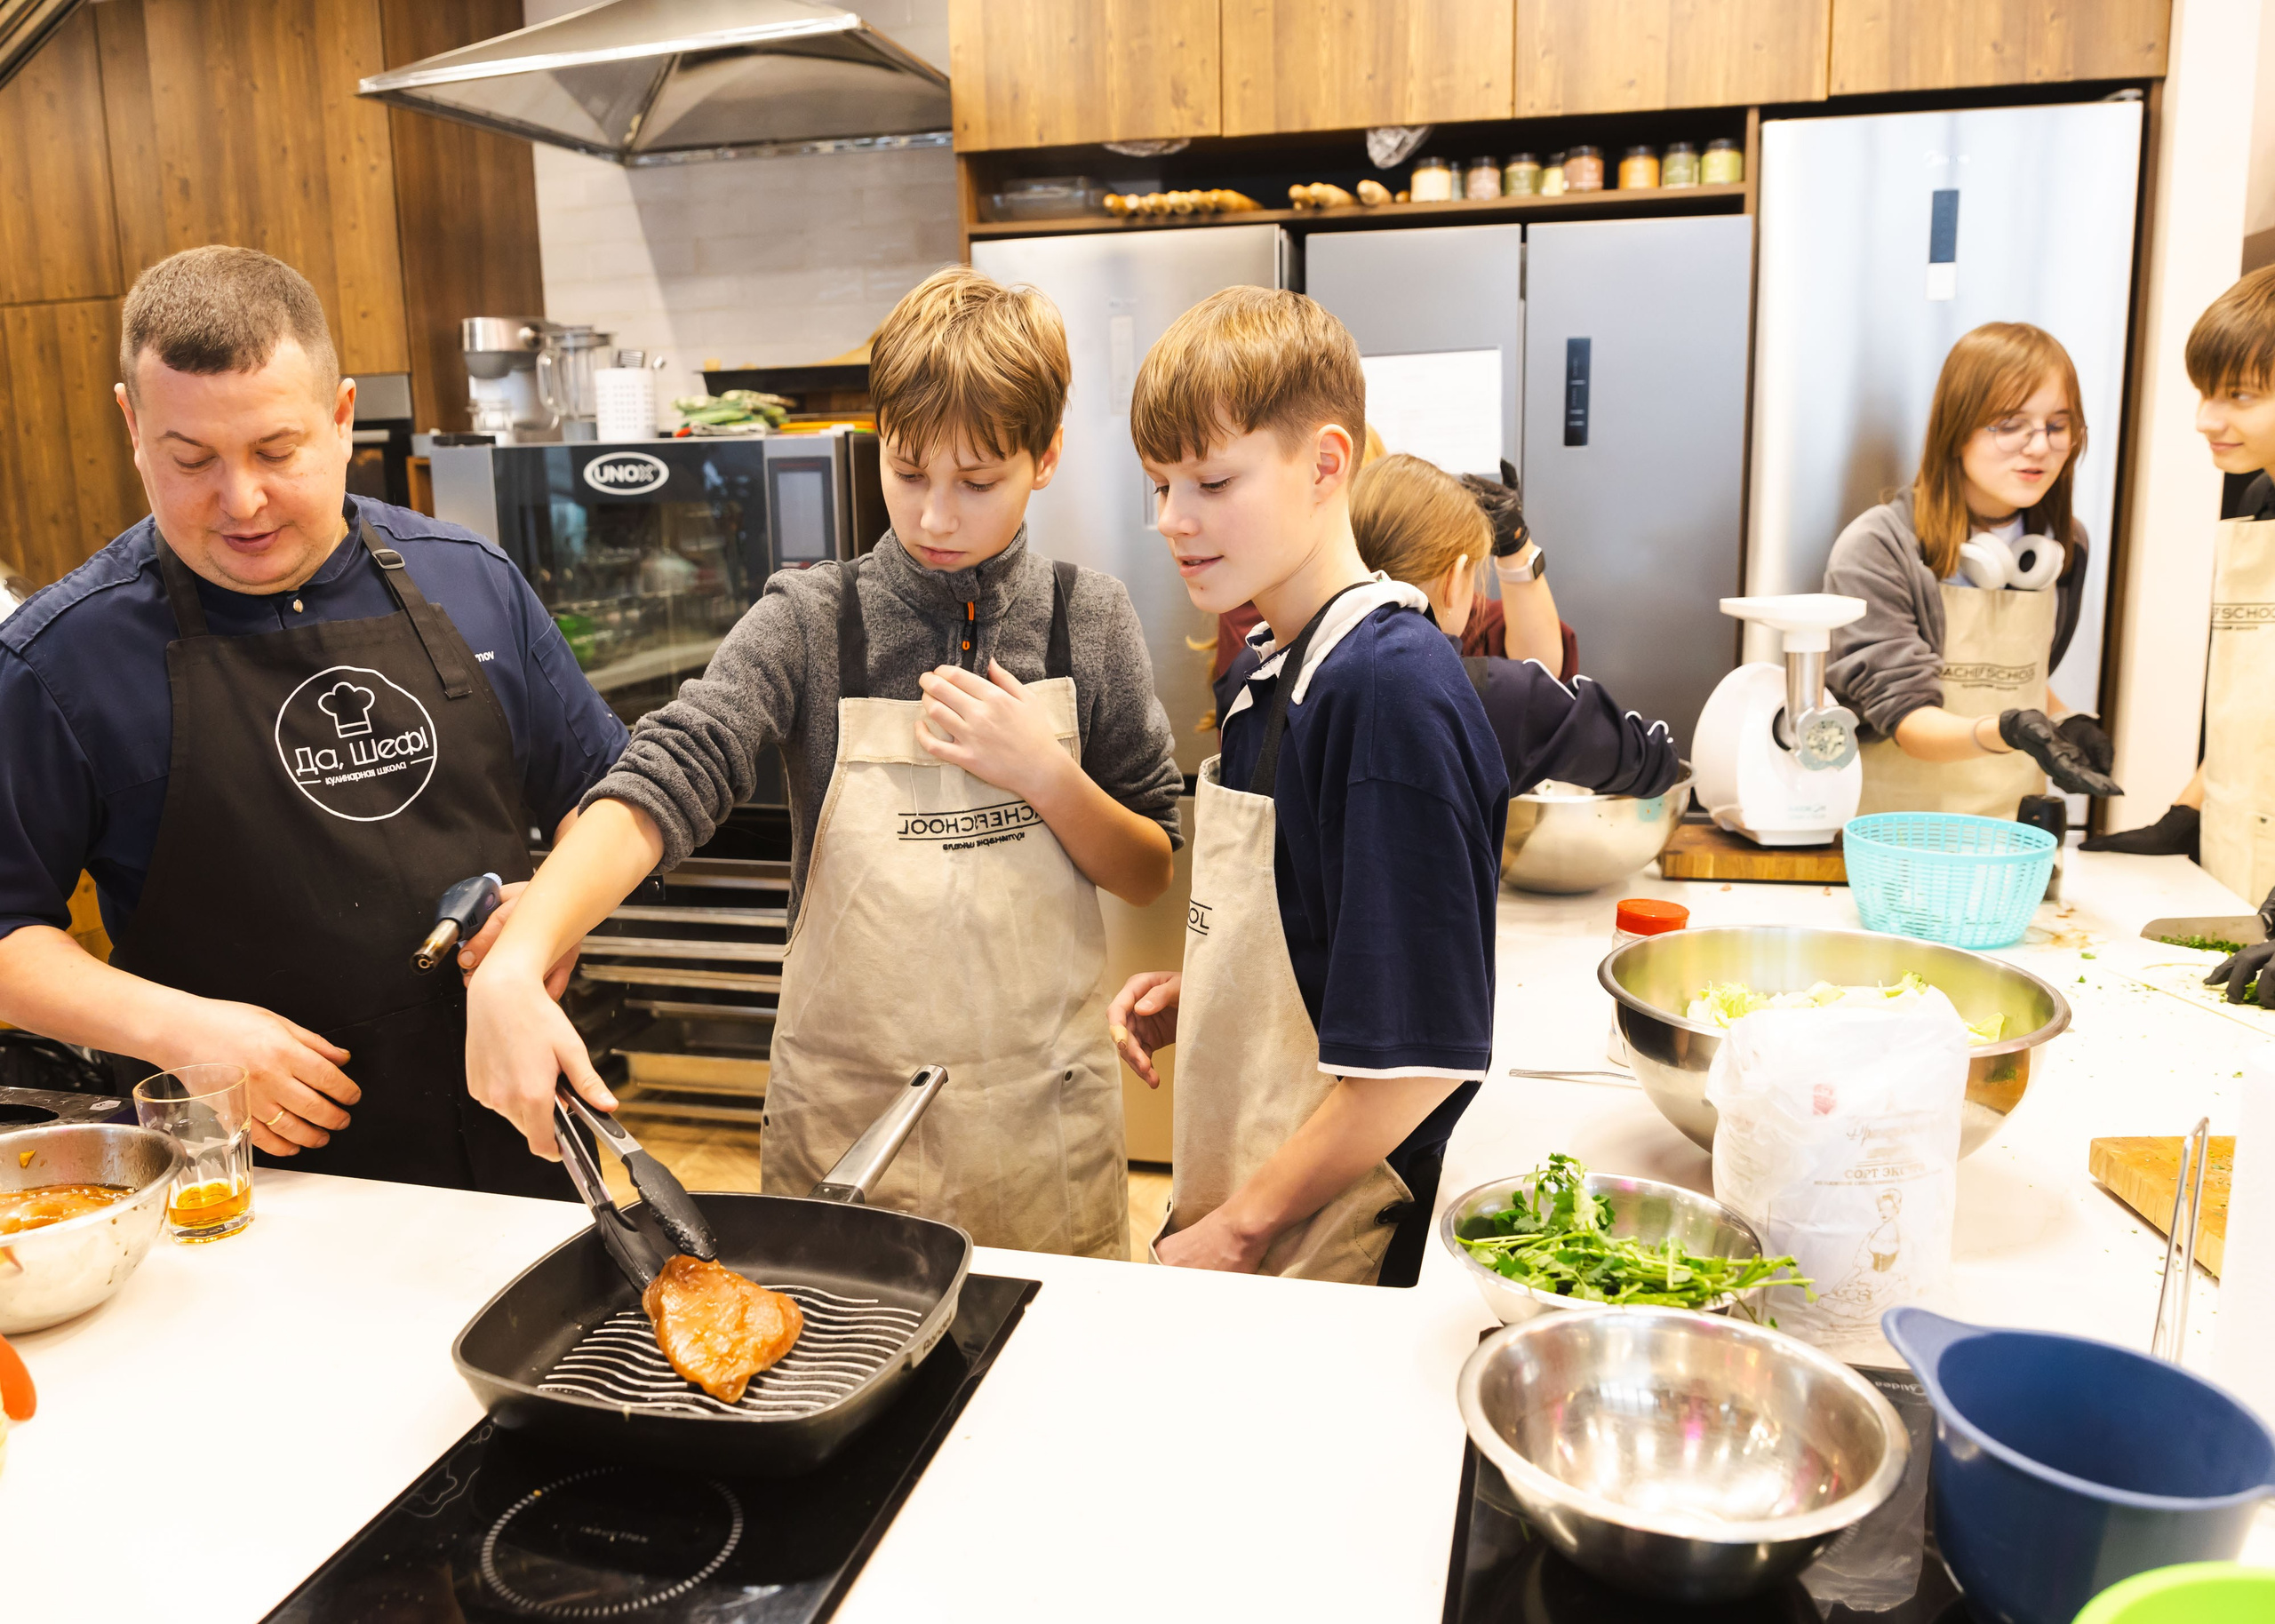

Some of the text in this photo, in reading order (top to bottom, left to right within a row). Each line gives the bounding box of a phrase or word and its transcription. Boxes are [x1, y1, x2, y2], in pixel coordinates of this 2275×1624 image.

[595, 464, 655, 484] UNOX
[294, 726, 430, 777] Да, Шеф!
[324, 761, 407, 786] кулинарная школа
[1188, 907, 1209, 929] OL
[1844, 1167, 1880, 1180] СОРТ
